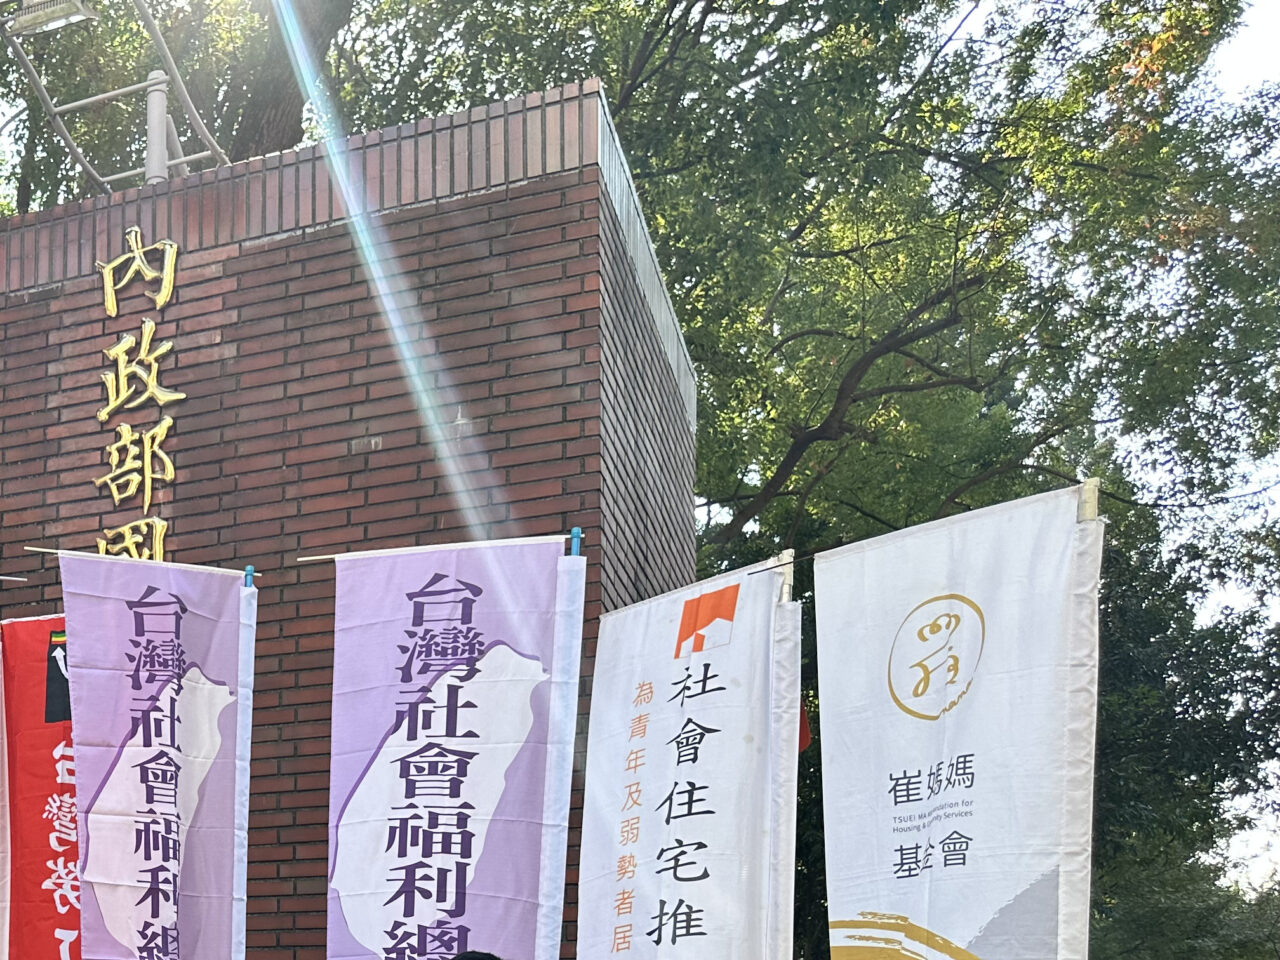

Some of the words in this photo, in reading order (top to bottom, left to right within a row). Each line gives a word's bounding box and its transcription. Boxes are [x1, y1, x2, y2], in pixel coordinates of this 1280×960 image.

[888, 753, 976, 807] 崔媽媽
[893, 830, 974, 880] 基金會
